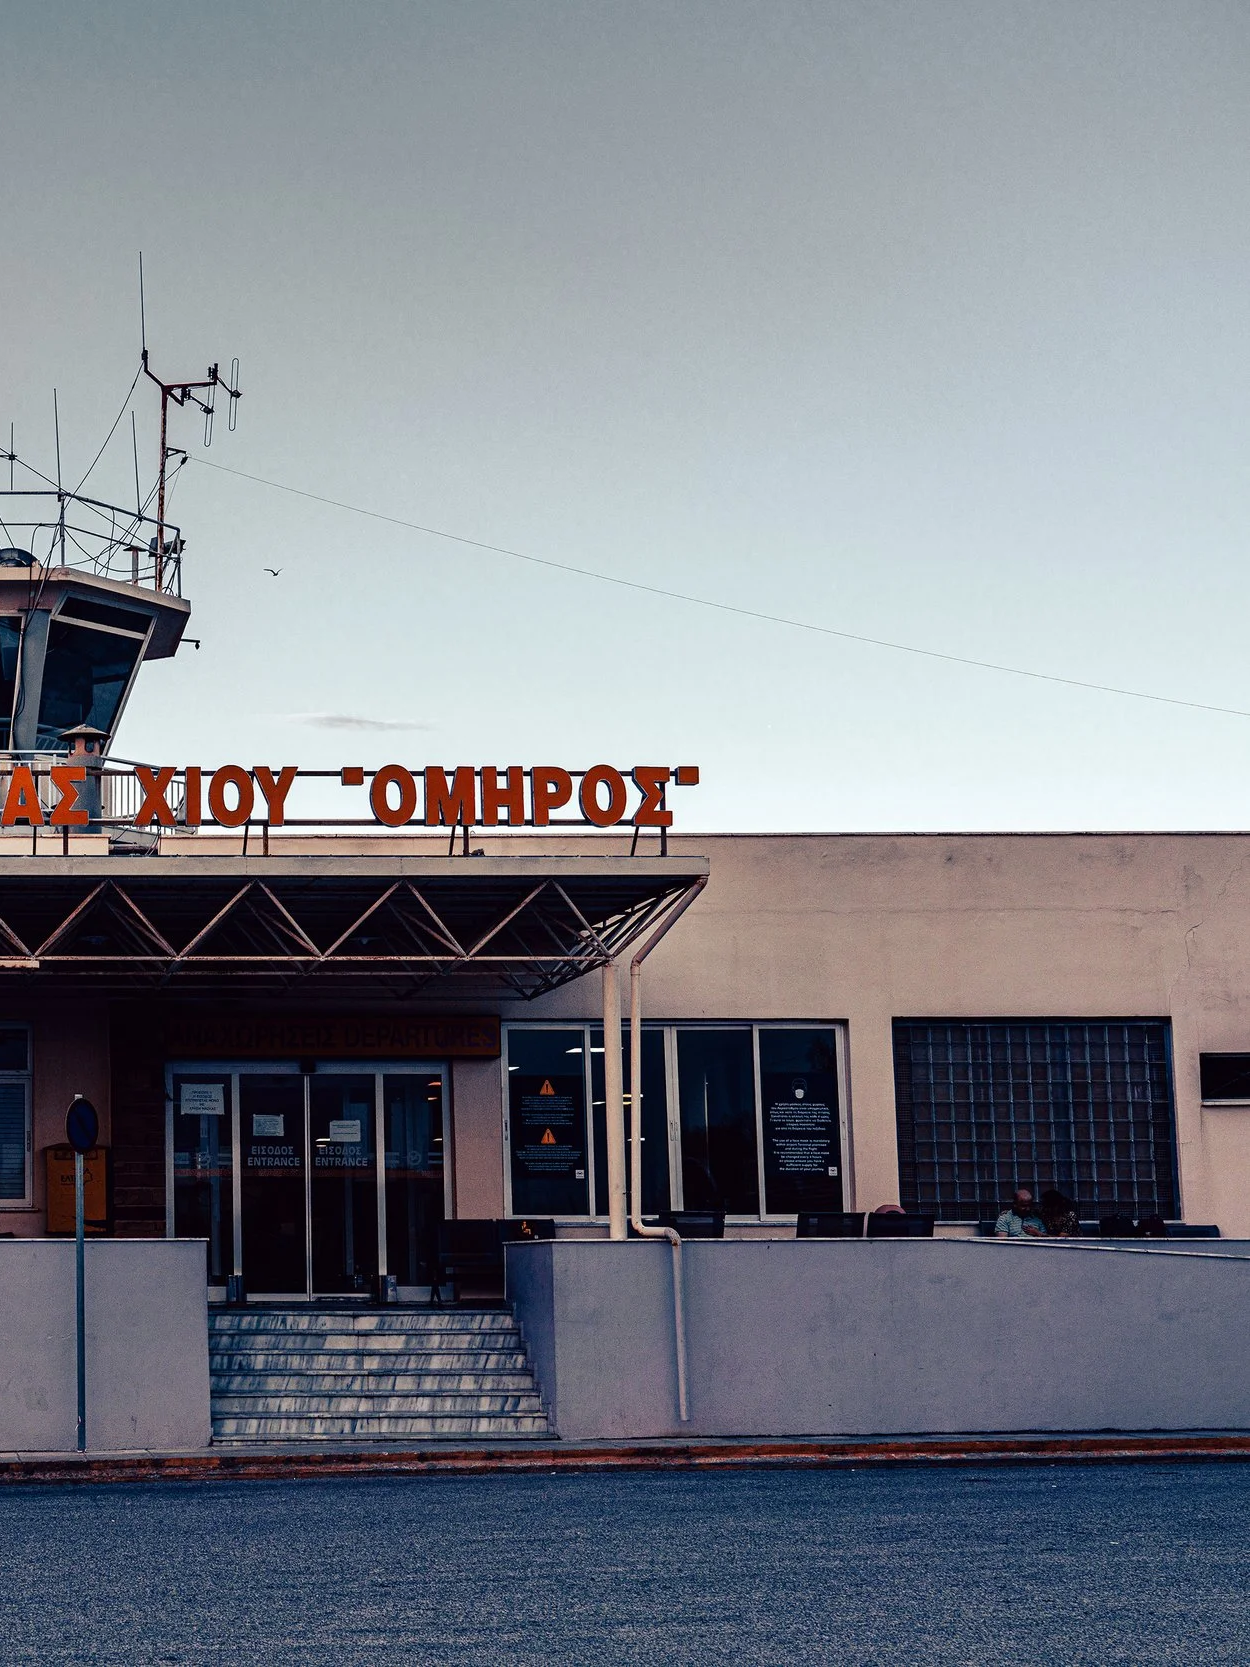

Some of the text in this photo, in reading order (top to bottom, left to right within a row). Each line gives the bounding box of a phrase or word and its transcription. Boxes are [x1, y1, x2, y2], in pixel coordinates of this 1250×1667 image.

[133, 764, 299, 828] ΧΙΟΥ
[345, 1023, 498, 1048] DEPARTURES
[251, 1145, 294, 1155] ΕΙΣΟΔΟΣ
[247, 1156, 300, 1167] ENTRANCE
[315, 1156, 368, 1167] ENTRANCE
